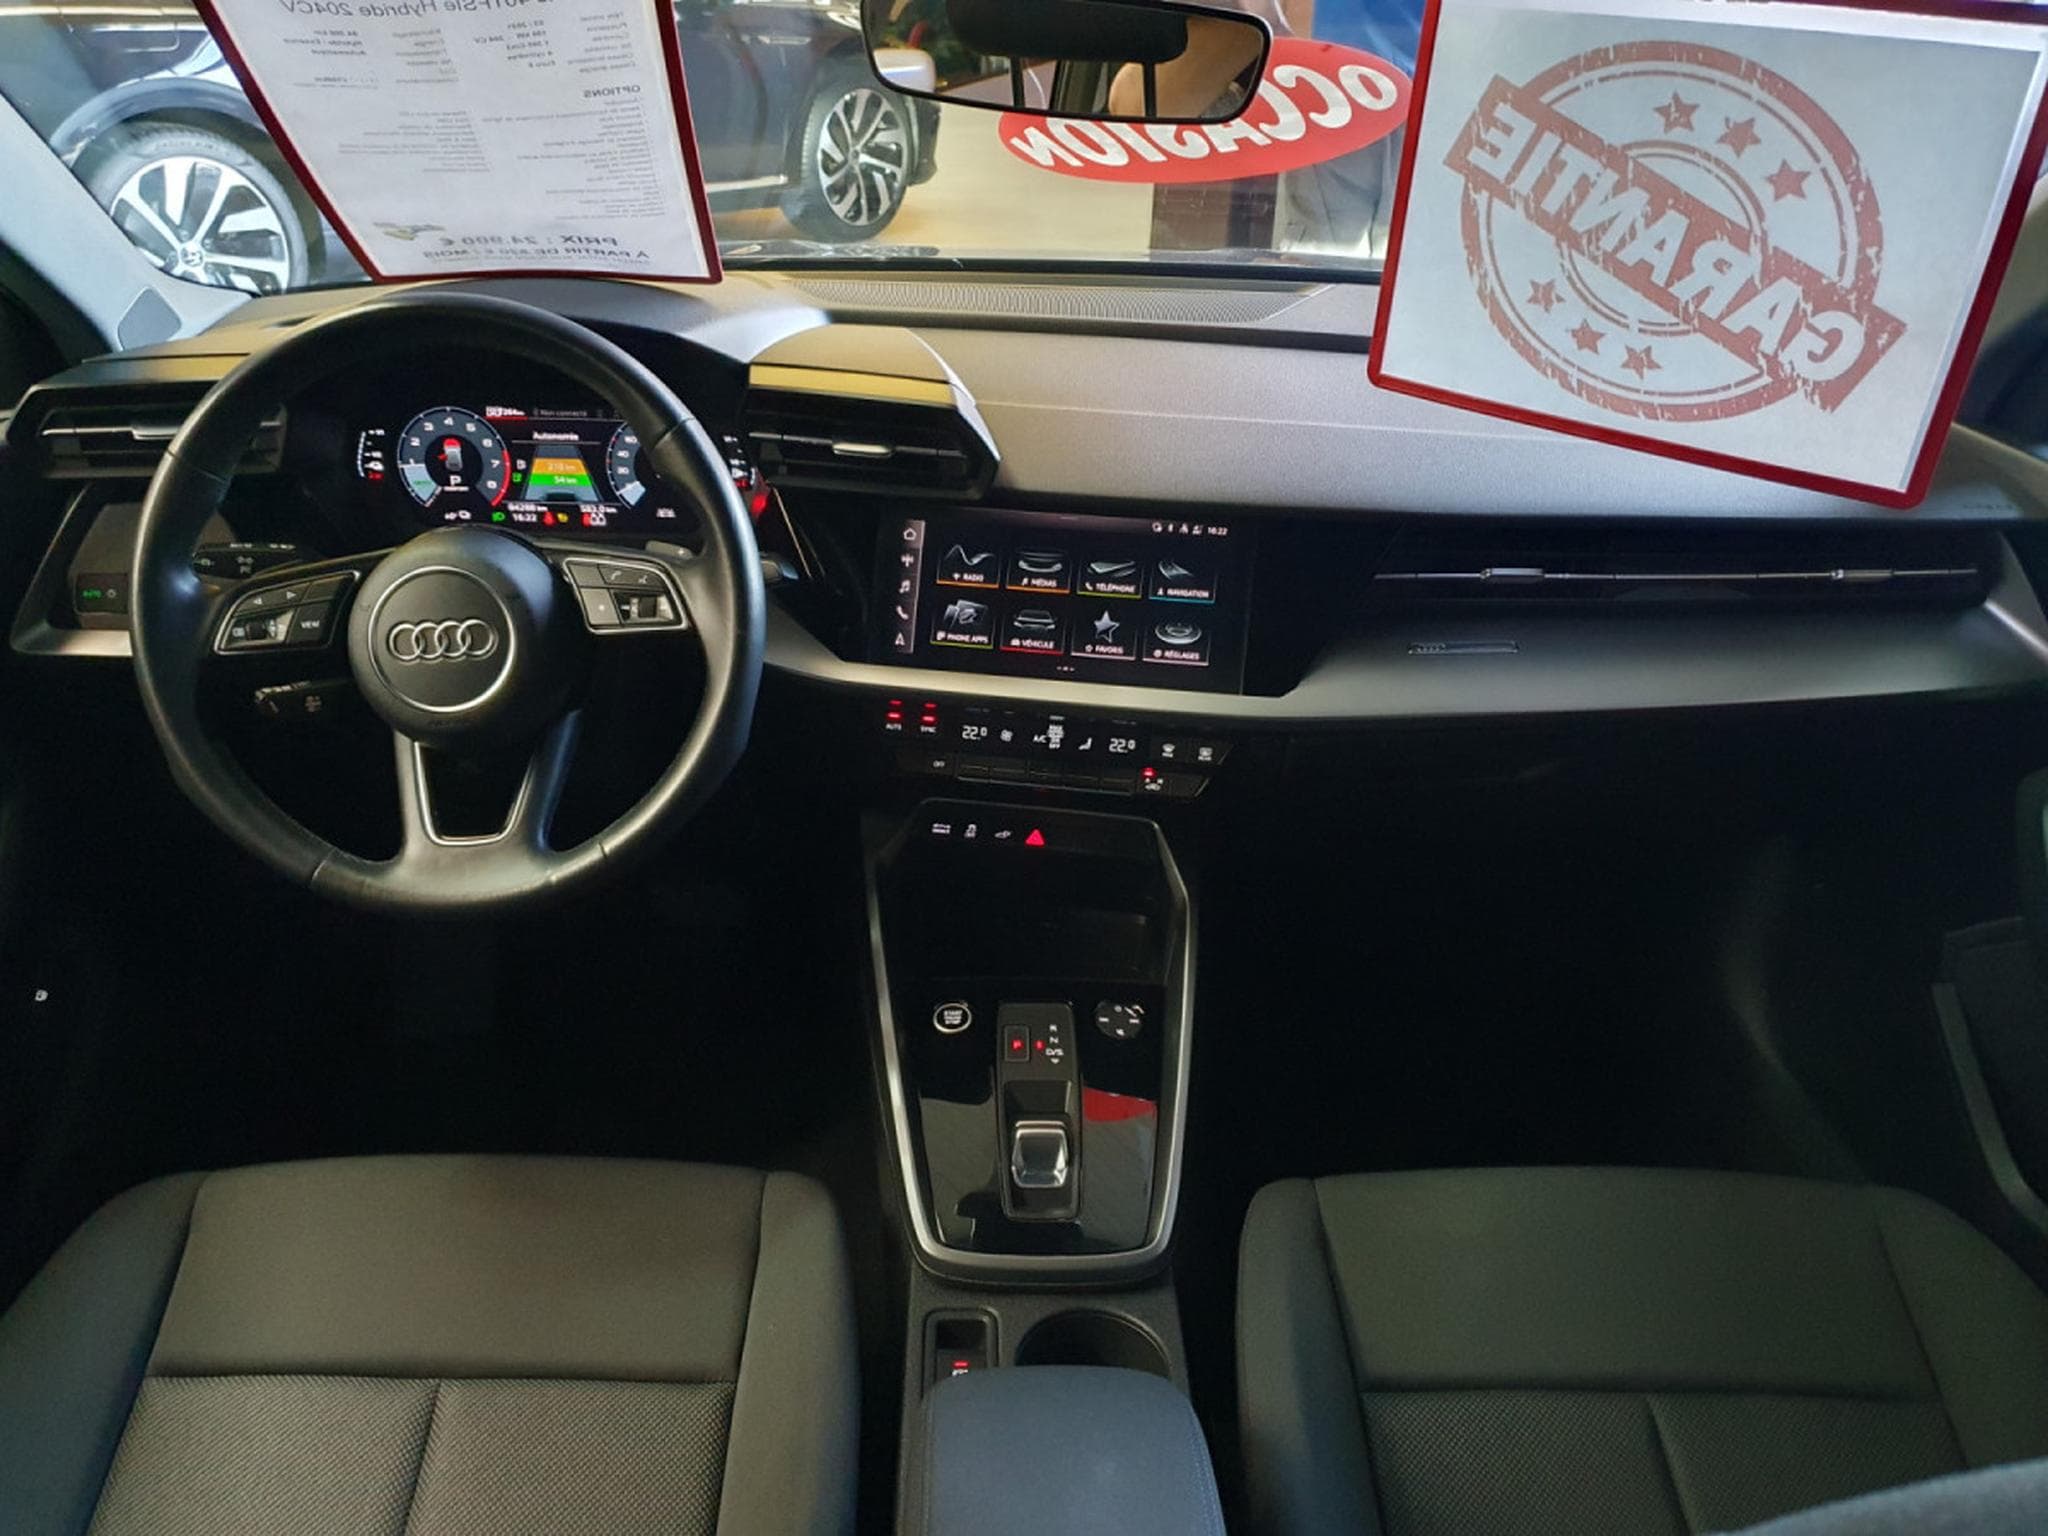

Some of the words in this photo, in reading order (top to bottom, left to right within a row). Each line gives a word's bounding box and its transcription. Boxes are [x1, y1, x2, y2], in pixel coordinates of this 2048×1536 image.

[424, 422, 434, 431] 3
[443, 417, 453, 426] 4
[466, 422, 476, 432] 5
[410, 436, 420, 447] 2
[483, 438, 493, 448] 6
[490, 459, 500, 468] 7
[450, 475, 461, 486] P
[962, 572, 985, 582] RADIO
[1167, 587, 1209, 598] NAVIGATION
[946, 632, 970, 643] PHONE
[971, 635, 989, 644] APPS
[1094, 644, 1124, 655] FAVORIS
[1012, 1040, 1022, 1049] P
